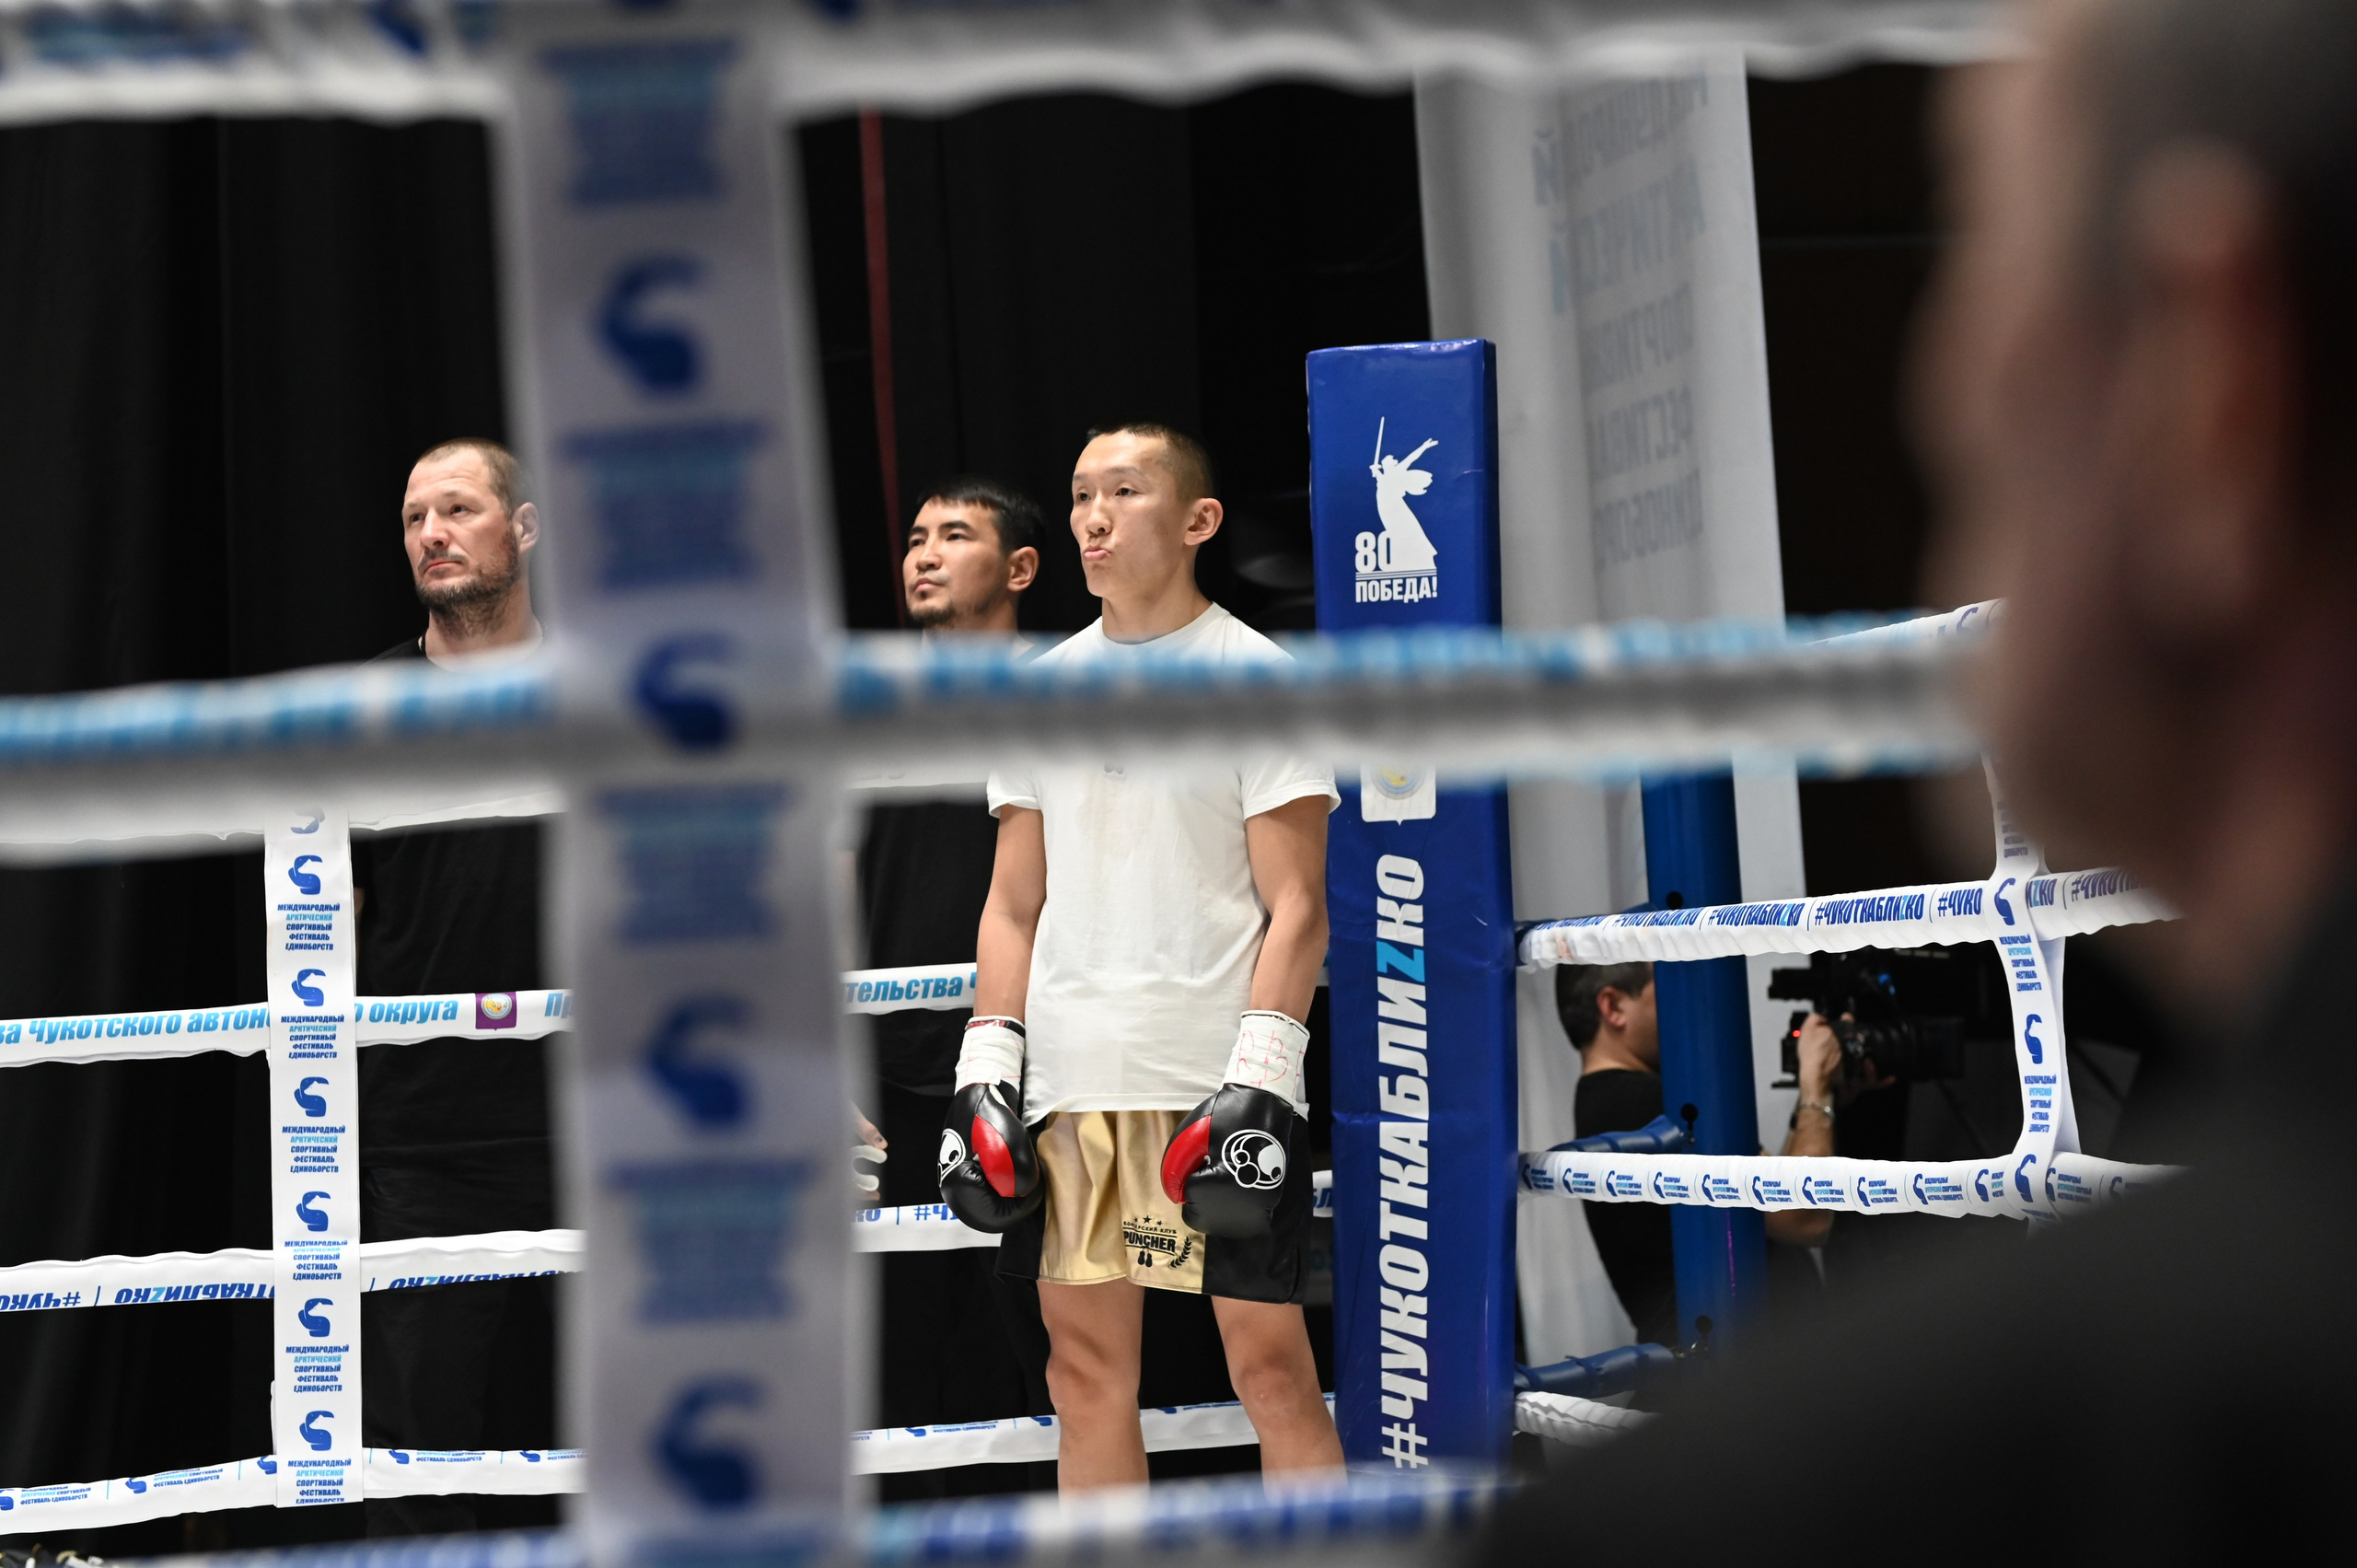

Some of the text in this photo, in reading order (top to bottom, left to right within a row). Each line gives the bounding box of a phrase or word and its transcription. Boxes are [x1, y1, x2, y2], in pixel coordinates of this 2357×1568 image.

[1355, 530, 1391, 573] 80
[1355, 576, 1438, 604] ПОБЕДА!
[1937, 887, 1983, 918] #ЧУКО
[277, 903, 341, 912] МЕЖДУНАРОДНЫЙ
[1815, 893, 1925, 926] #ЧУКОТКАБЛИZКО
[1708, 902, 1806, 927] #ЧУКОТКАБЛИZКО
[286, 923, 332, 931] СПОРТИВНЫЙ
[289, 933, 330, 941] ФЕСТИВАЛЬ
[285, 943, 333, 951] ЕДИНОБОРСТВ
[29, 1013, 182, 1045] Чукотского
[368, 1000, 458, 1025] округа
[281, 1015, 344, 1024] МЕЖДУНАРОДНЫЙ
[290, 1033, 336, 1041] СПОРТИВНЫЙ
[289, 1051, 337, 1060] ЕДИНОБОРСТВ
[282, 1125, 345, 1134] МЕЖДУНАРОДНЫЙ
[291, 1144, 337, 1153] СПОРТИВНЫЙ
[1376, 854, 1429, 1469] #ЧУКОТКАБЛИZКО
[290, 1166, 339, 1174] ЕДИНОБОРСТВ
[1123, 1231, 1177, 1253] PUNCHER
[293, 1272, 342, 1281] ЕДИНОБОРСТВ
[0, 1291, 81, 1311] #ЧУКО
[285, 1344, 350, 1354] МЕЖДУНАРОДНЫЙ
[295, 1364, 341, 1373] СПОРТИВНЫЙ
[297, 1375, 338, 1383] ФЕСТИВАЛЬ
[294, 1384, 343, 1393] ЕДИНОБОРСТВ
[288, 1458, 352, 1468] МЕЖДУНАРОДНЫЙ
[153, 1480, 184, 1488] ФЕСТИВАЛЬ
[296, 1477, 343, 1487] СПОРТИВНЫЙ
[20, 1497, 51, 1505] ФЕСТИВАЛЬ
